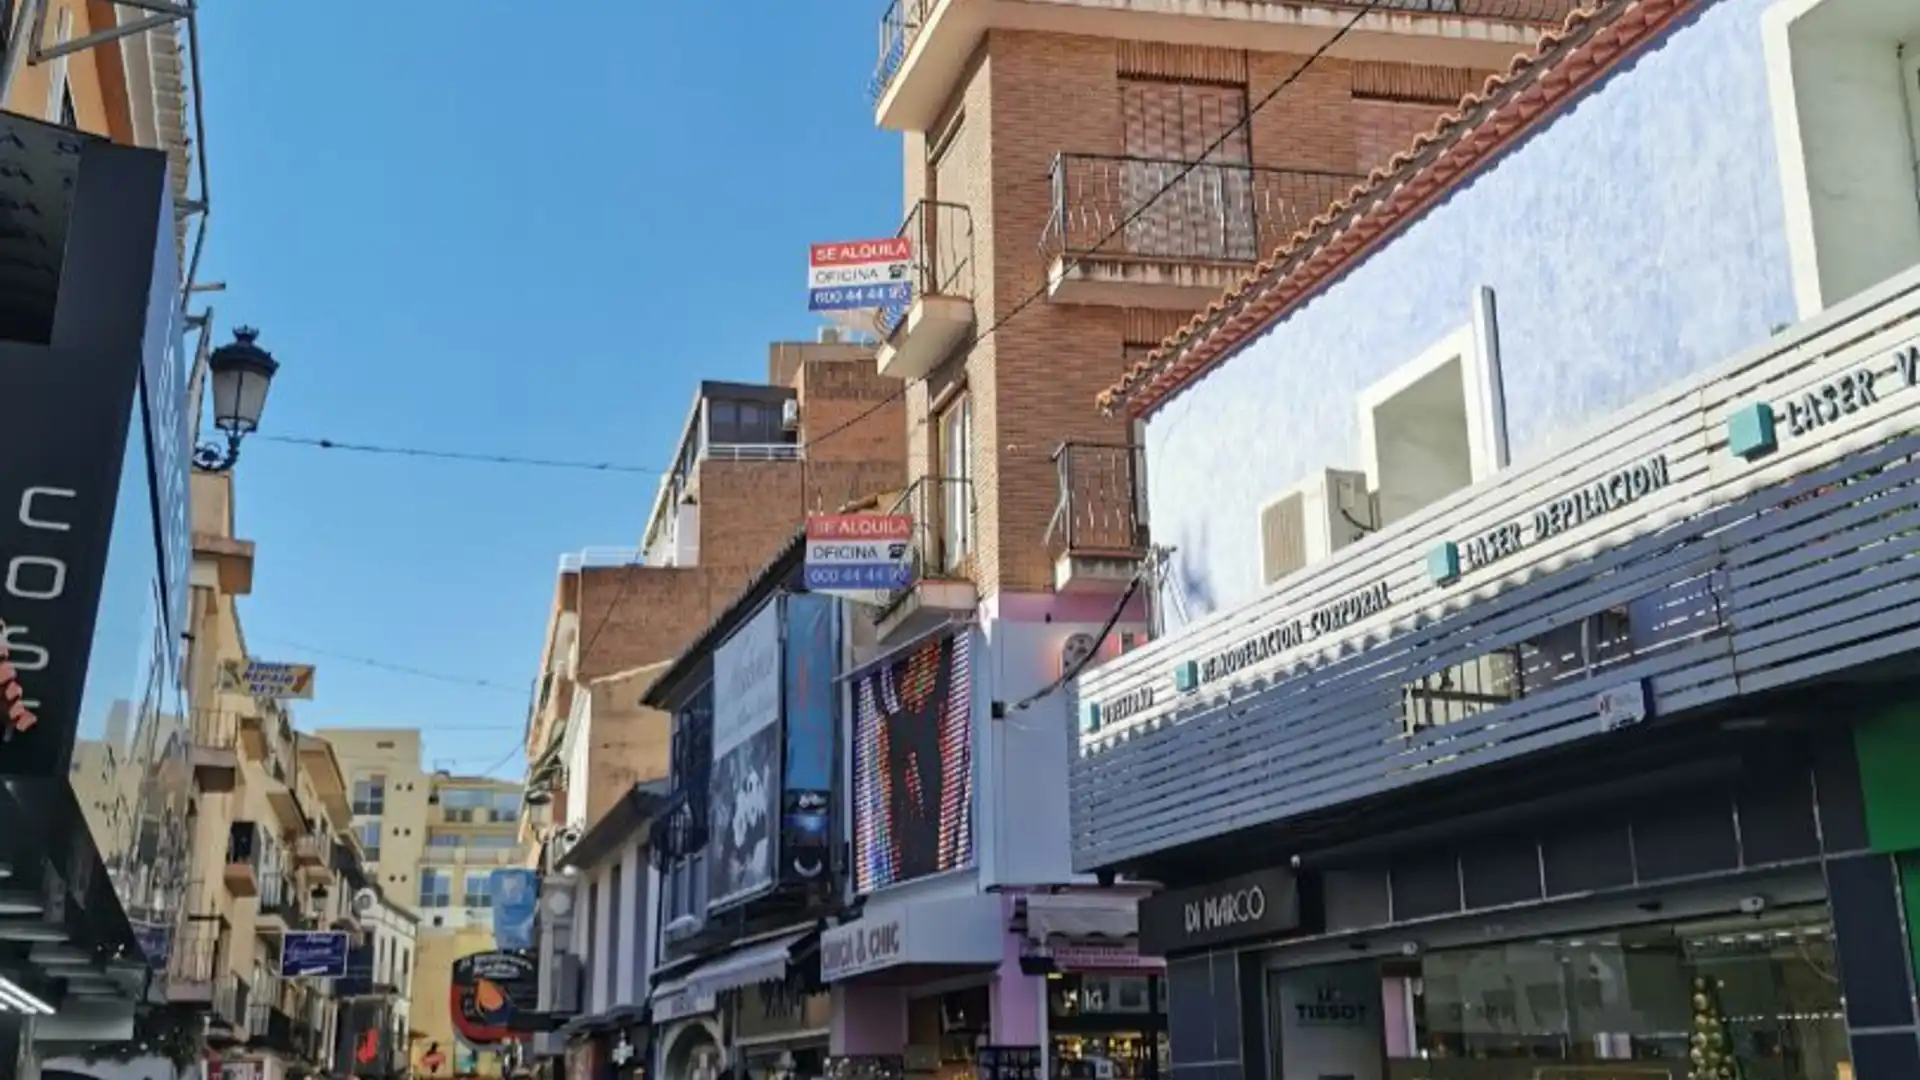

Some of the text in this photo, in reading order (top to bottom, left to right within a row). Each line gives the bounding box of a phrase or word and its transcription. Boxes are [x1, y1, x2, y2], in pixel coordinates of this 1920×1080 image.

[815, 241, 907, 261] SE ALQUILA
[815, 268, 878, 284] OFICINA
[814, 290, 843, 304] 600
[845, 287, 862, 301] 44
[867, 286, 884, 300] 44
[1786, 369, 1878, 436] LASER
[1467, 454, 1671, 568] LASER DEPILACION
[813, 519, 908, 535] SE ALQUILA
[813, 545, 878, 560] OFICINA
[1185, 886, 1264, 932] DI MARCO
[869, 921, 899, 959] CHIC
[1295, 1003, 1366, 1023] TISSOT
